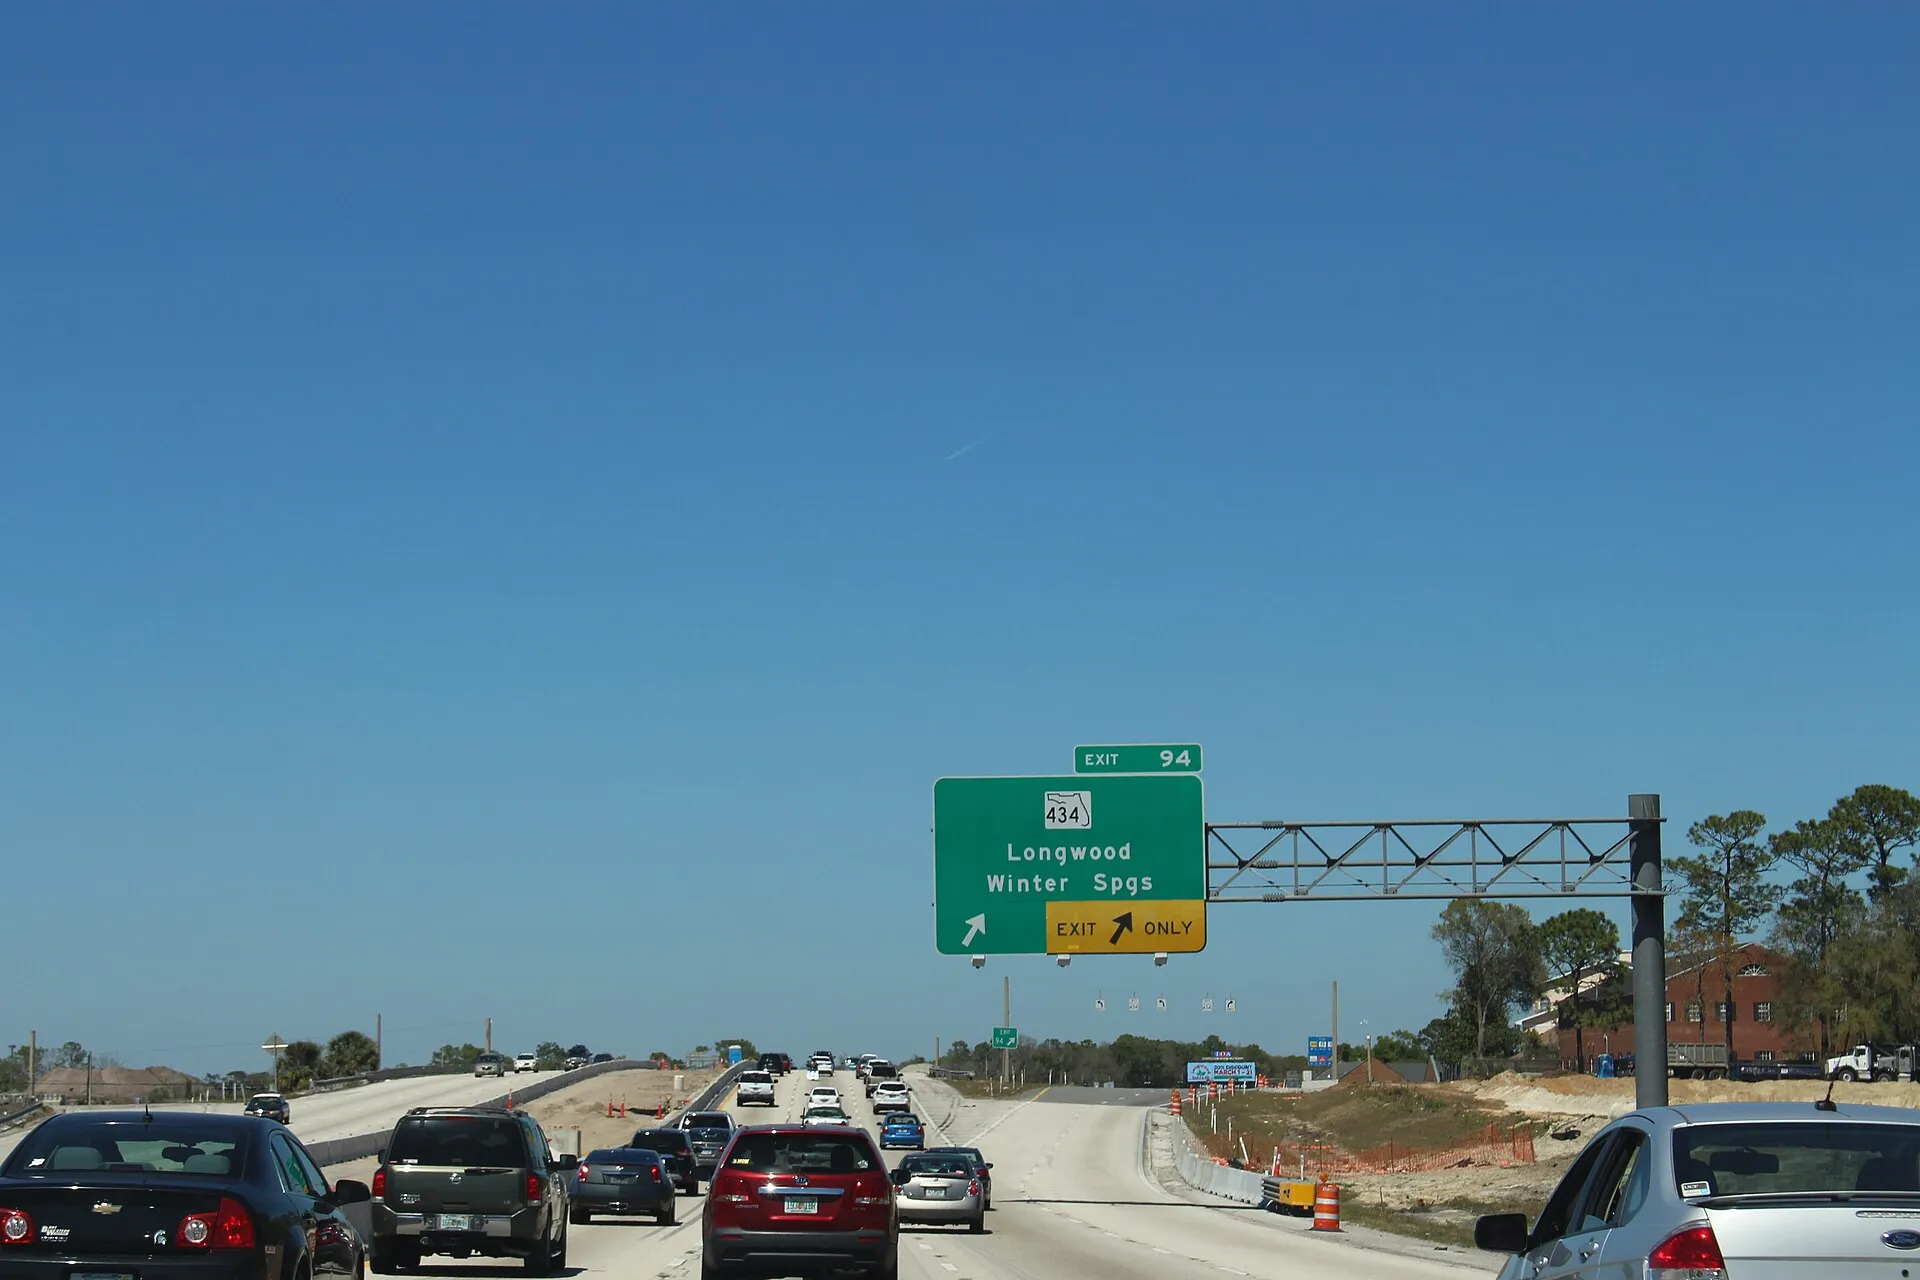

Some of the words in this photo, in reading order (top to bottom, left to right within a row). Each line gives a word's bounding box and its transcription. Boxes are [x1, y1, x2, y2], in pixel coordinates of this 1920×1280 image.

[1085, 753, 1119, 766] EXIT
[1159, 749, 1191, 768] 94
[1046, 806, 1080, 823] 434
[1007, 842, 1131, 866] Longwood
[987, 874, 1069, 893] Winter
[1093, 873, 1153, 896] Spgs
[1057, 922, 1097, 937] EXIT
[1144, 920, 1193, 936] ONLY
